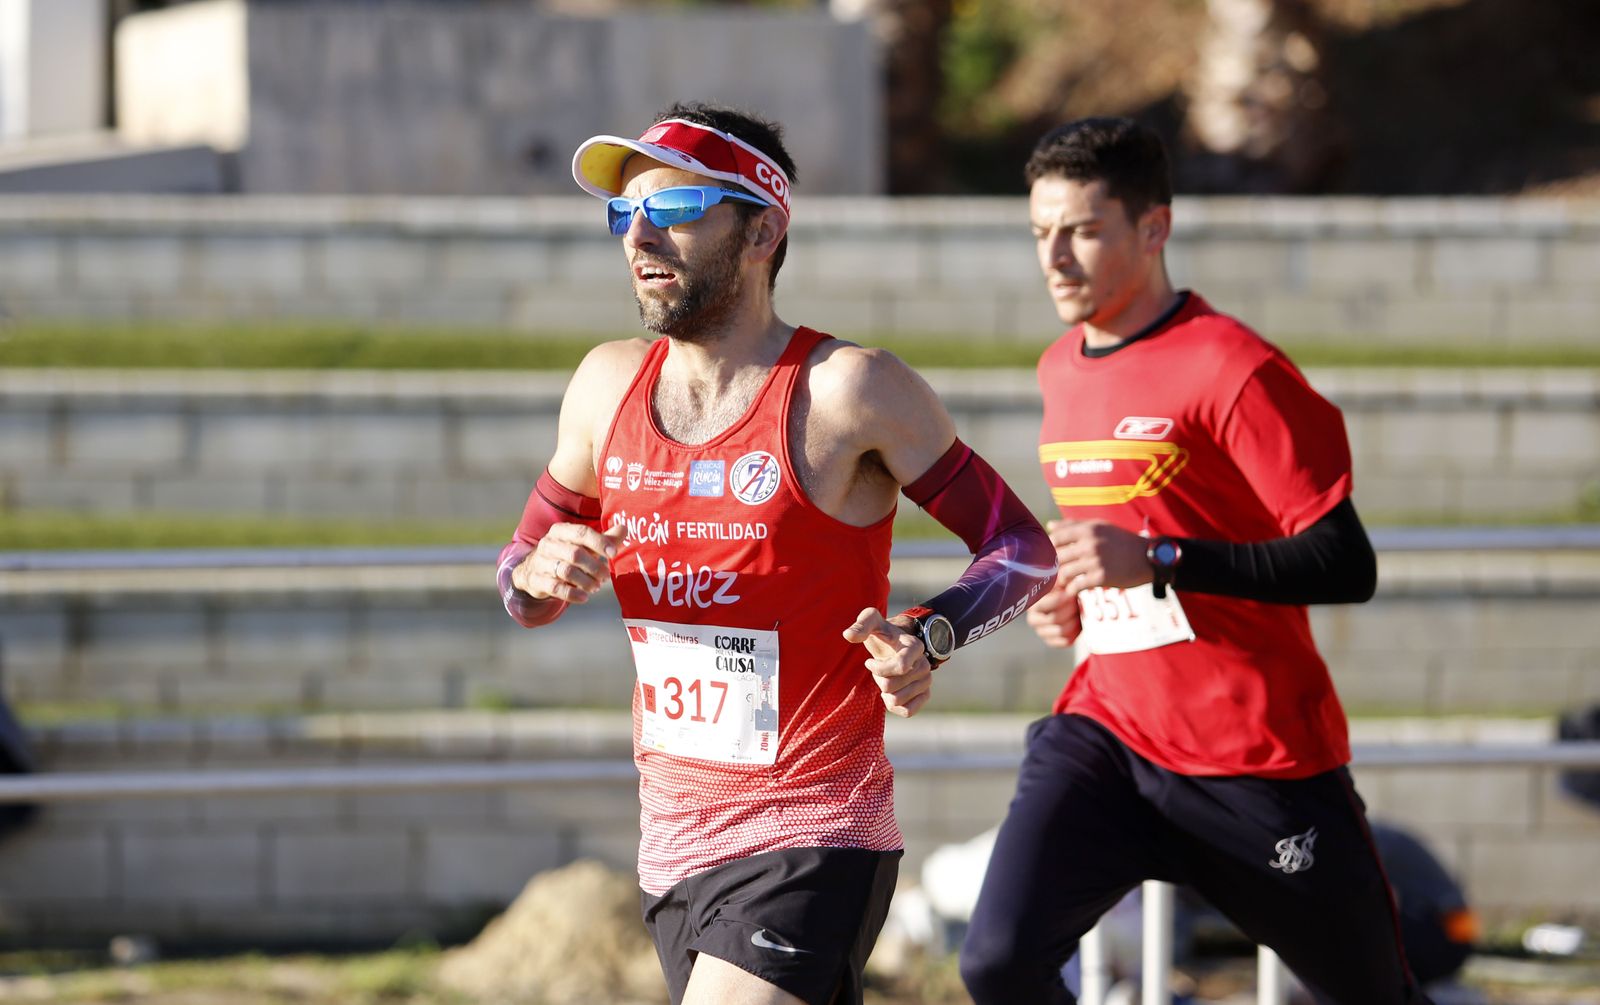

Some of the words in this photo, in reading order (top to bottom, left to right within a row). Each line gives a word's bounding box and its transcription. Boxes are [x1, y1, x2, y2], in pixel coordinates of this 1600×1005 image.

[676, 521, 768, 540] FERTILIDAD
[636, 551, 741, 609] Vélez
[714, 634, 757, 654] CORRE
[715, 655, 756, 673] CAUSA
[663, 676, 729, 724] 317
[760, 731, 769, 752] ZONA
